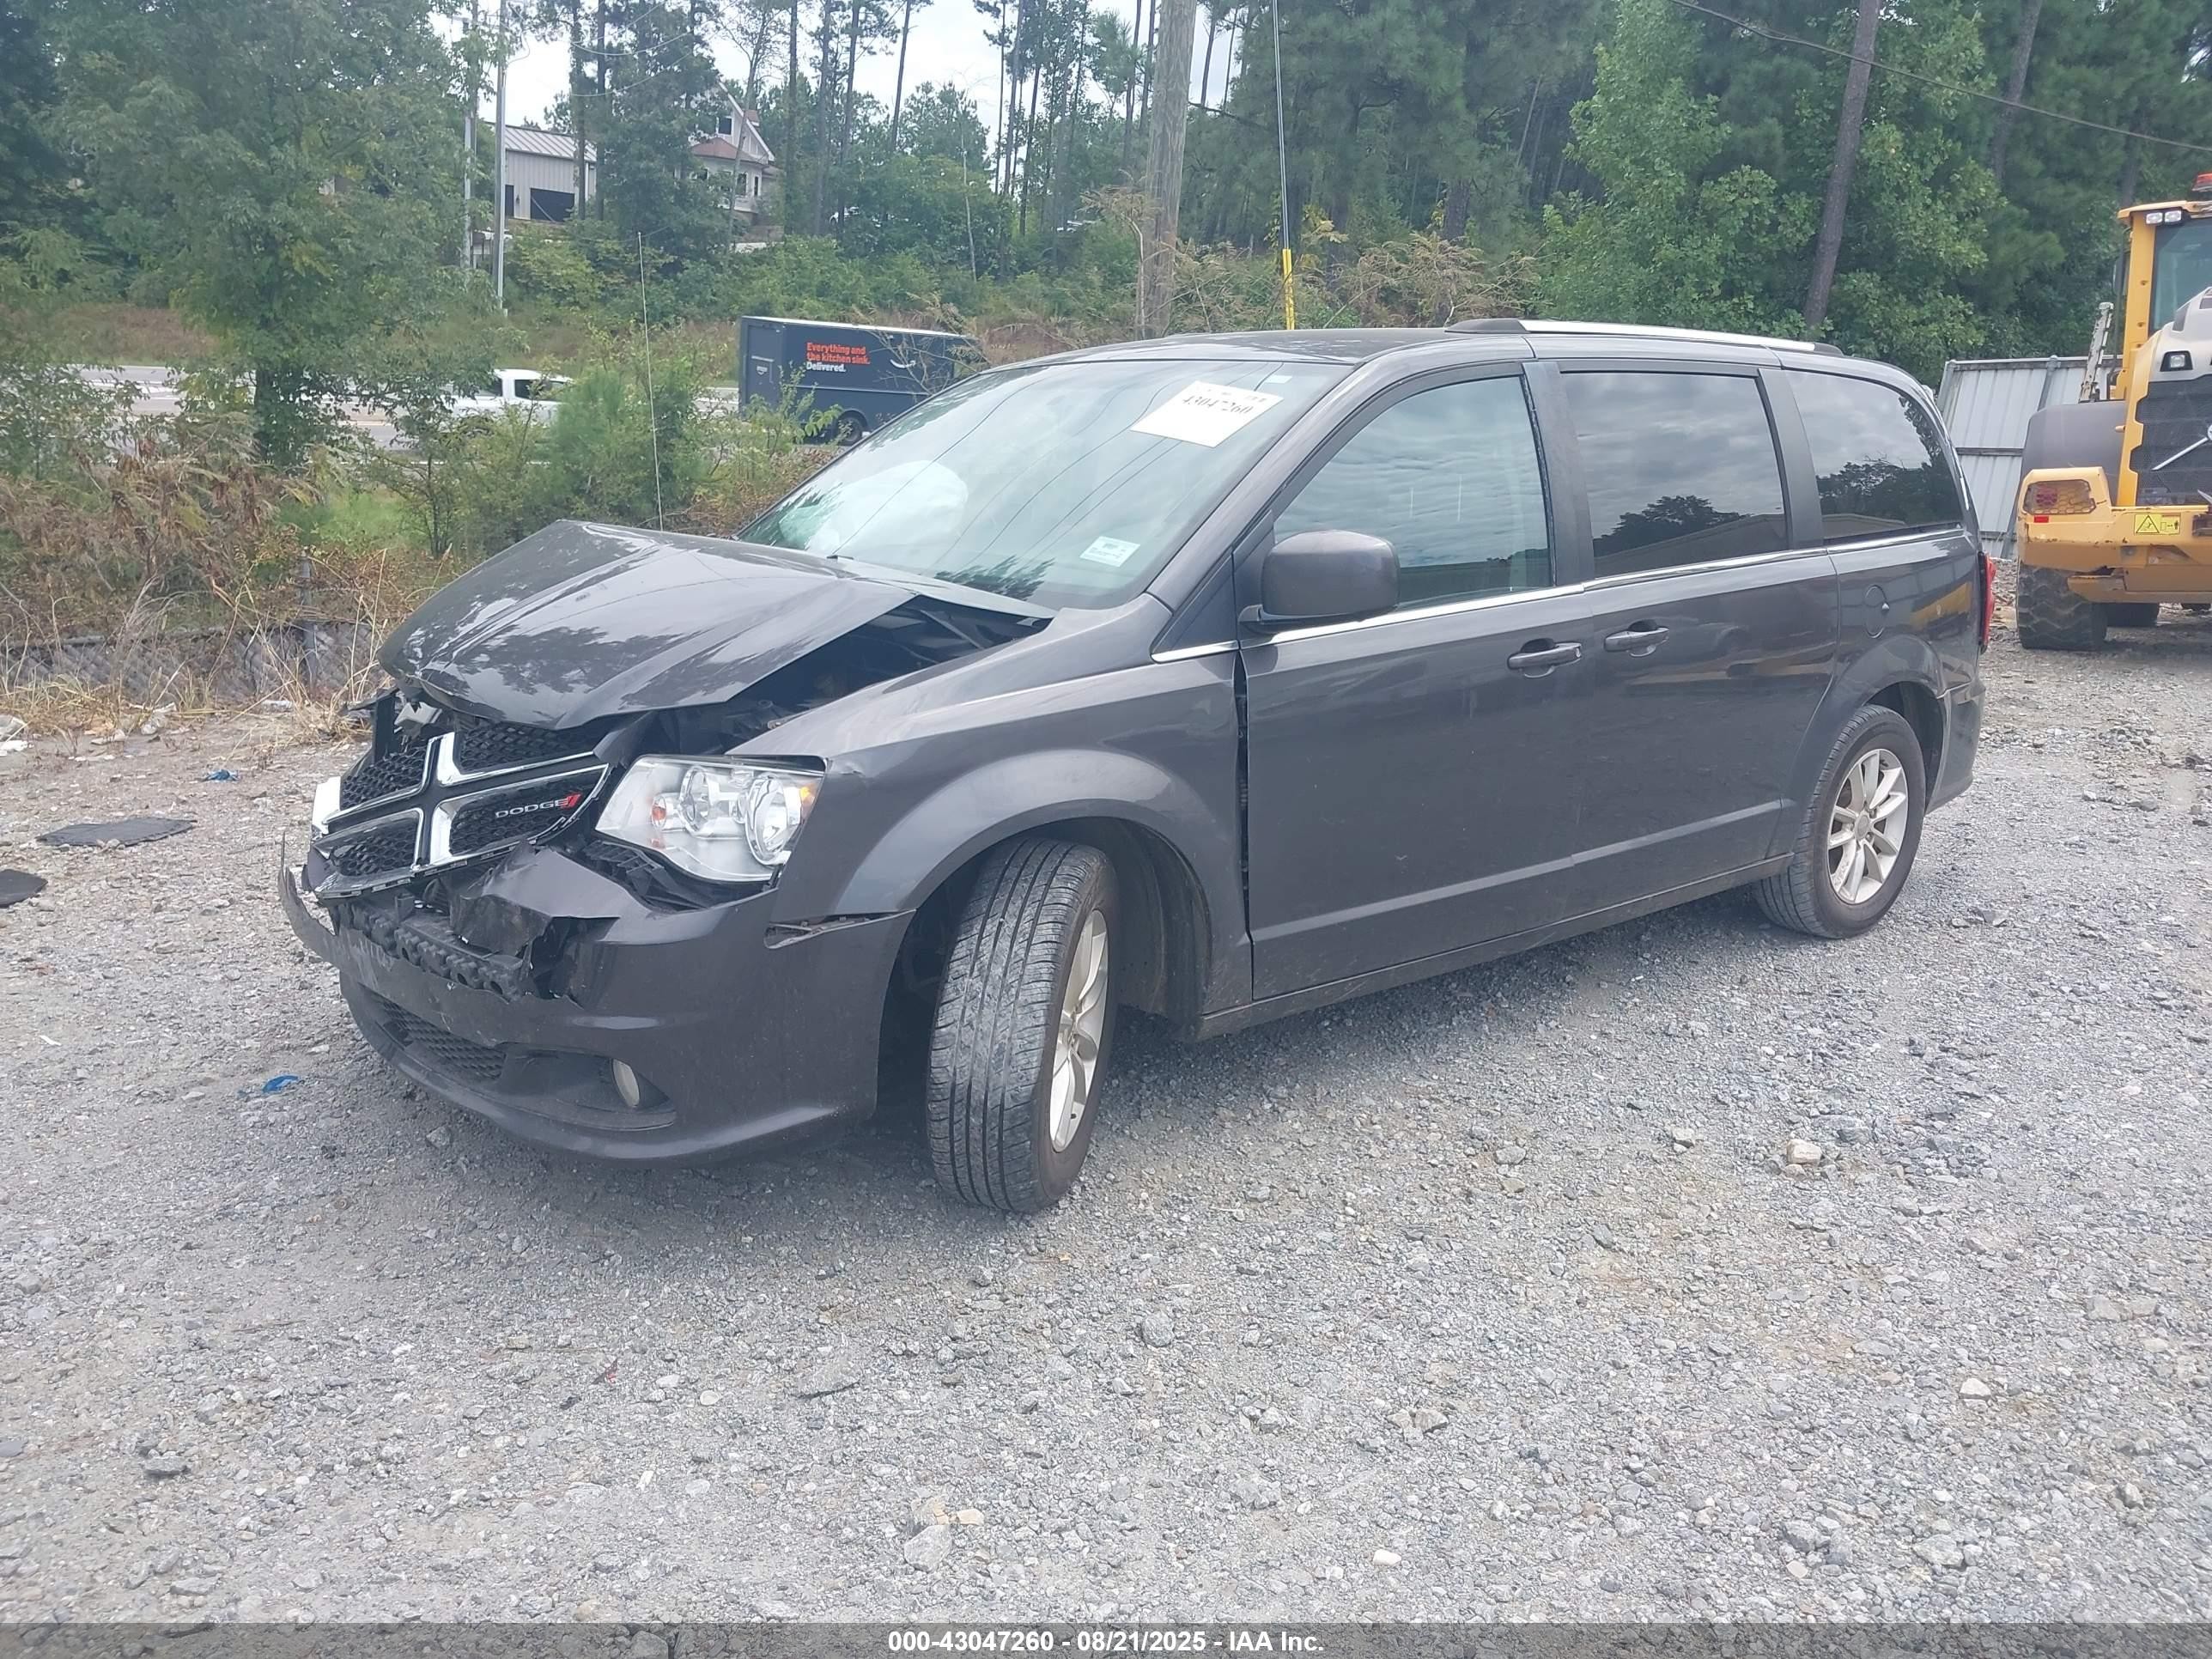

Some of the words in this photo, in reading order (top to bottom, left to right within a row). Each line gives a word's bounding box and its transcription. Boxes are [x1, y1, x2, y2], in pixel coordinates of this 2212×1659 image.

[807, 342, 849, 355] Everything
[851, 346, 866, 355] and
[806, 351, 820, 361] the
[822, 353, 851, 363] kitchen
[852, 355, 871, 364] sink.
[806, 362, 846, 372] Delivered.
[495, 799, 568, 817] DODGE
